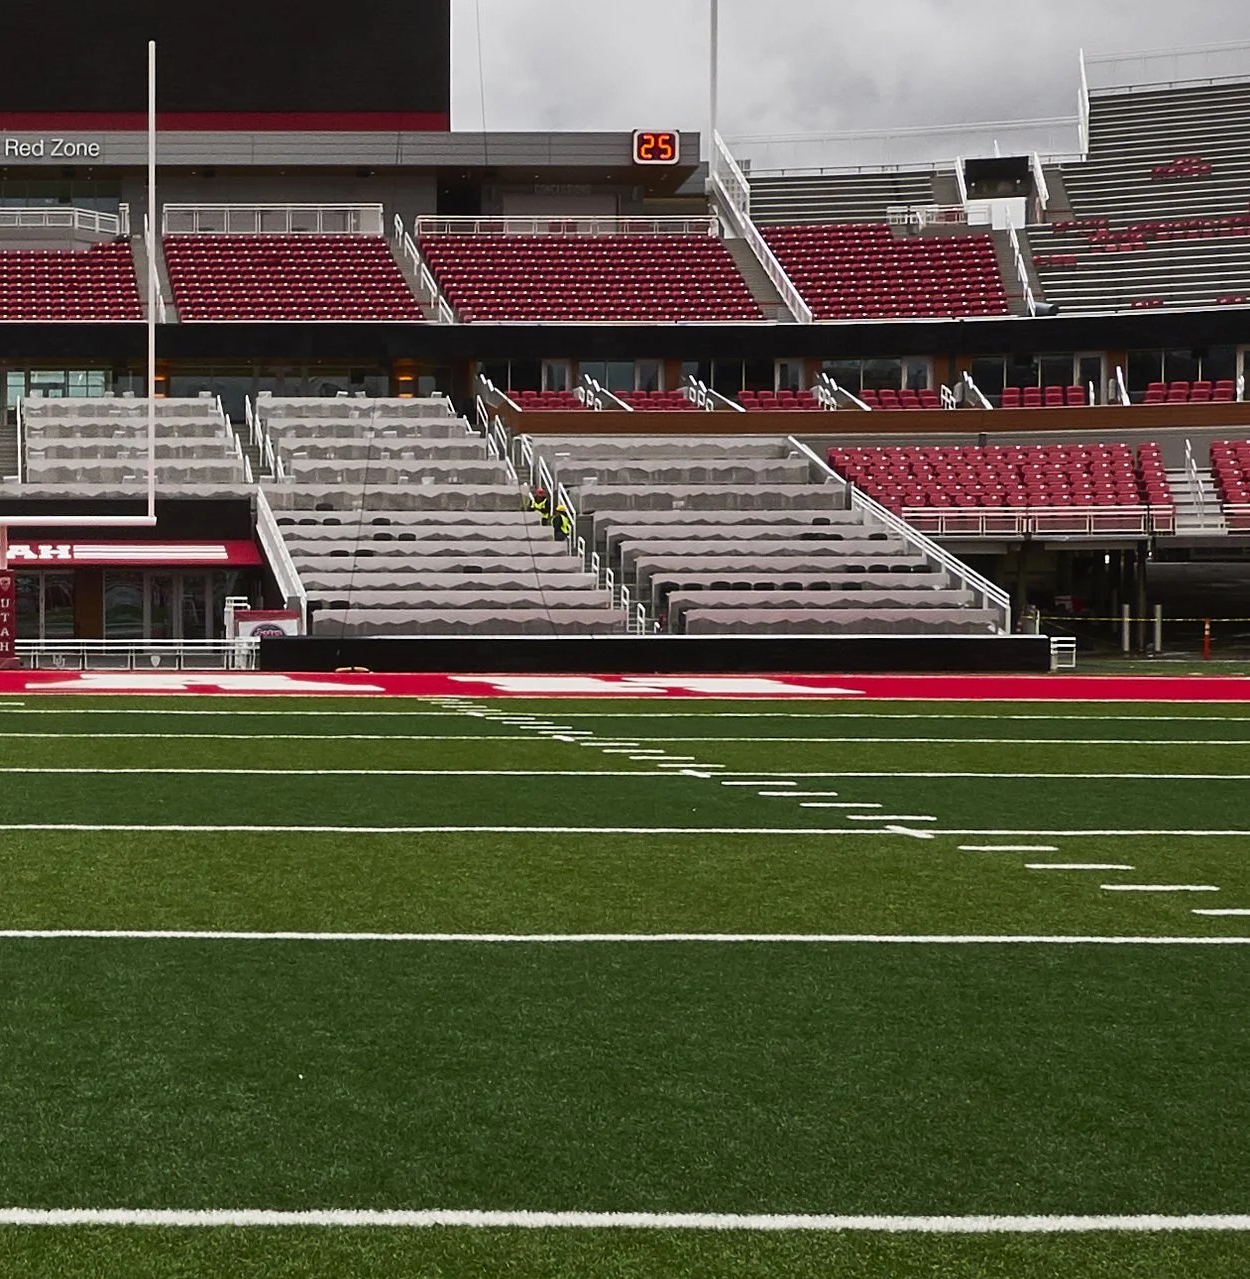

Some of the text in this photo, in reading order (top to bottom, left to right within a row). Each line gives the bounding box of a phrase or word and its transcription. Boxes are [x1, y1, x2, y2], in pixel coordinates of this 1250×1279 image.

[5, 138, 44, 157] Red
[50, 138, 100, 157] Zone
[640, 133, 672, 160] 25
[0, 598, 10, 652] UTAH
